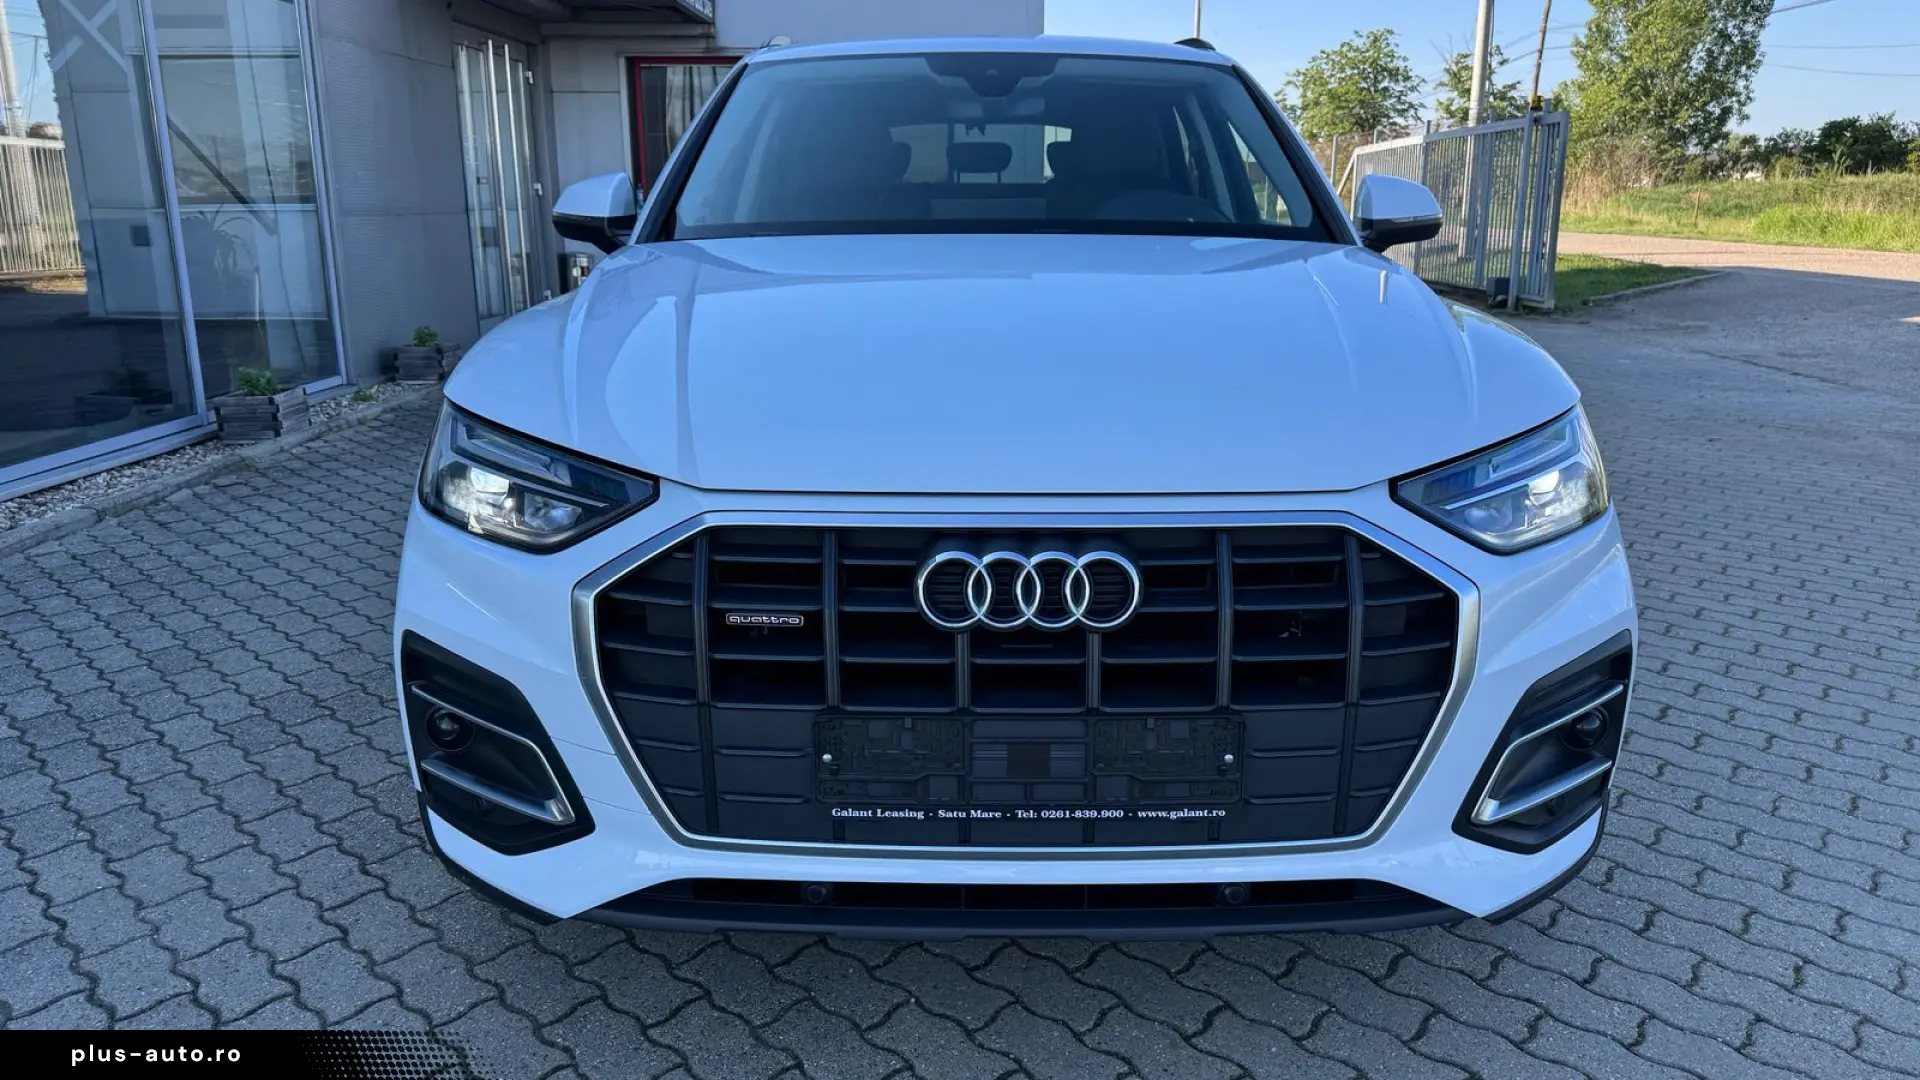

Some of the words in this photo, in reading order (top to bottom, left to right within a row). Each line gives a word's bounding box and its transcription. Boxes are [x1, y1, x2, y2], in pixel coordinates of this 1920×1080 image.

[729, 616, 800, 624] quattro
[831, 808, 873, 817] Galant
[876, 808, 925, 819] Leasing
[938, 809, 967, 818] Satu
[970, 809, 1002, 818] Mare
[1015, 809, 1038, 818] Tel:
[1041, 809, 1124, 818] 0261-839.900
[1137, 808, 1226, 820] www.galant.ro
